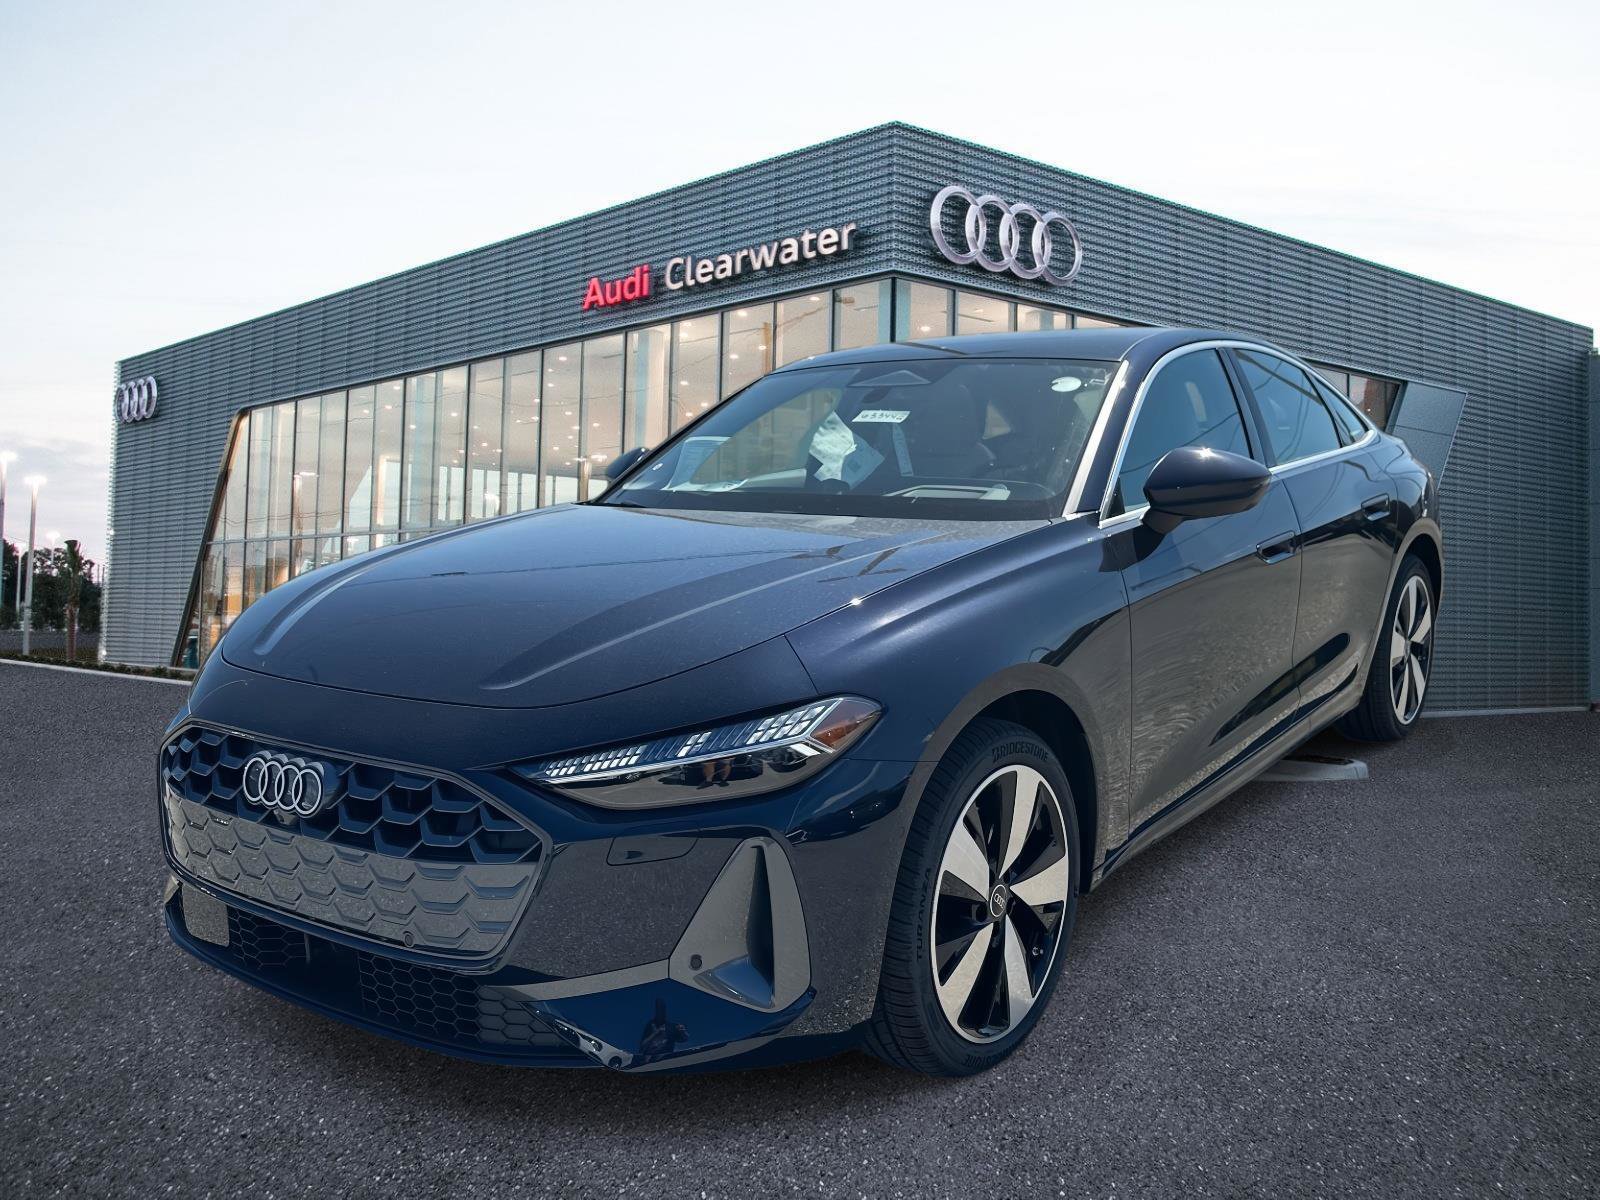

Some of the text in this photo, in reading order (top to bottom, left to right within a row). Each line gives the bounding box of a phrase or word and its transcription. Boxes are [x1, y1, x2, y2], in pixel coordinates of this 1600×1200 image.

[583, 223, 856, 310] Audi Clearwater
[991, 741, 1049, 763] BRIDGESTONE
[916, 868, 931, 962] TURANZA
